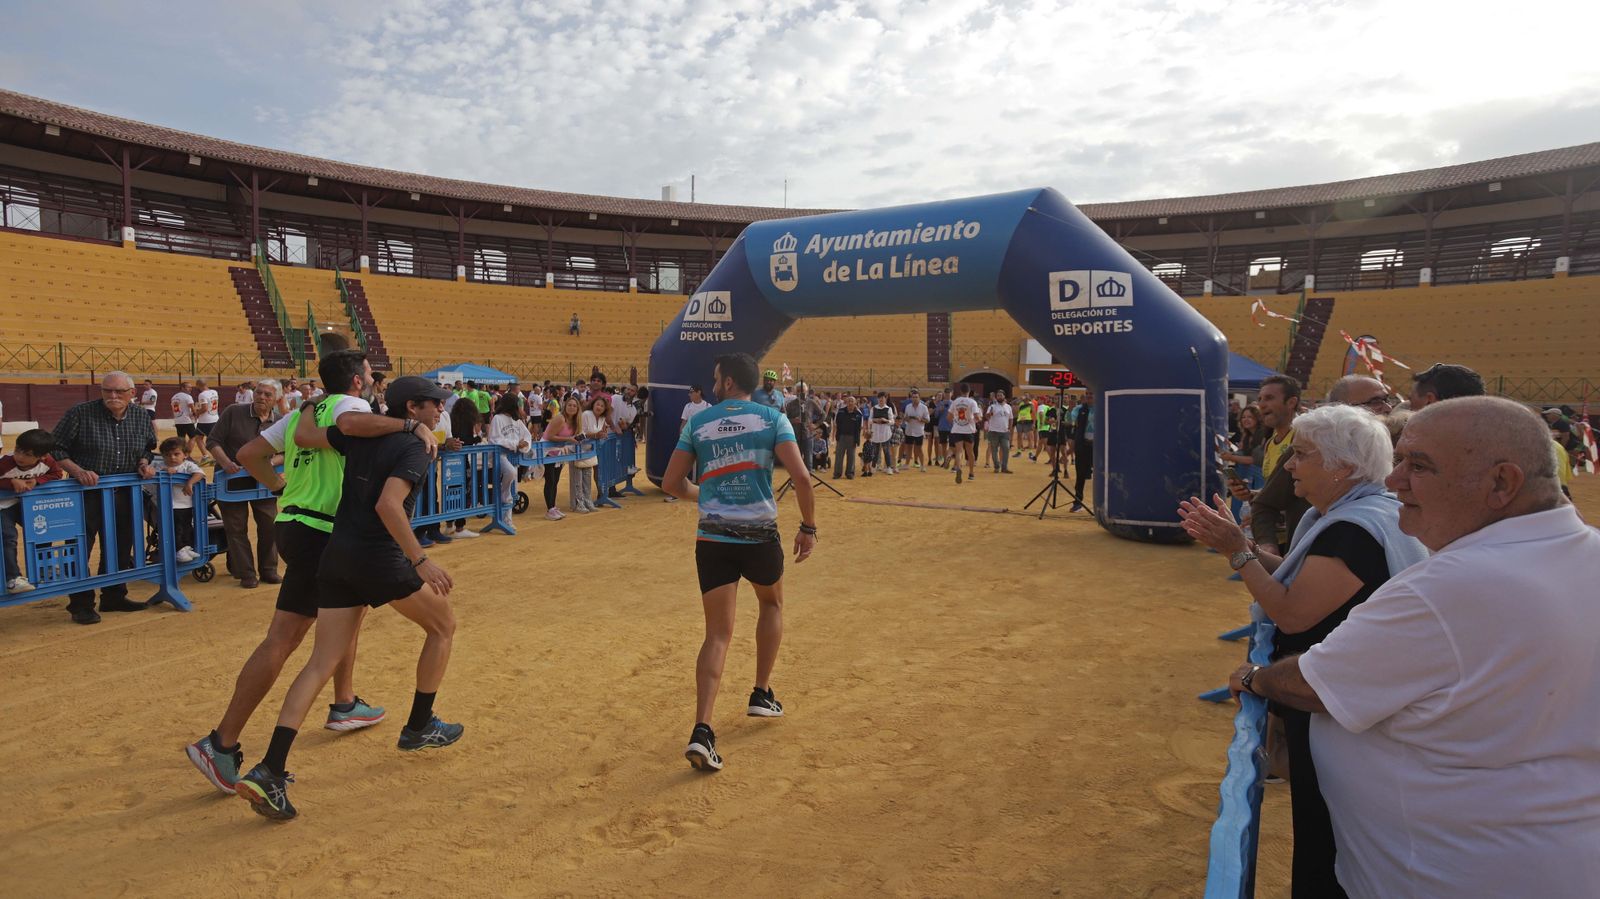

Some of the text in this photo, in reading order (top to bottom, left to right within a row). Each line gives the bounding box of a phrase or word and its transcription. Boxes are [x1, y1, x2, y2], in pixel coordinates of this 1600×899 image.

[804, 219, 980, 259] Ayuntamiento
[822, 253, 959, 283] de La Línea
[1058, 279, 1080, 302] D
[689, 299, 700, 315] D
[1051, 308, 1117, 320] DELEGACIÓN DE
[681, 321, 713, 329] DELEGACIÓN
[1053, 319, 1133, 336] DEPORTES
[680, 331, 735, 341] DEPORTES
[712, 443, 734, 458] Deja
[32, 501, 74, 511] DEPORTES
